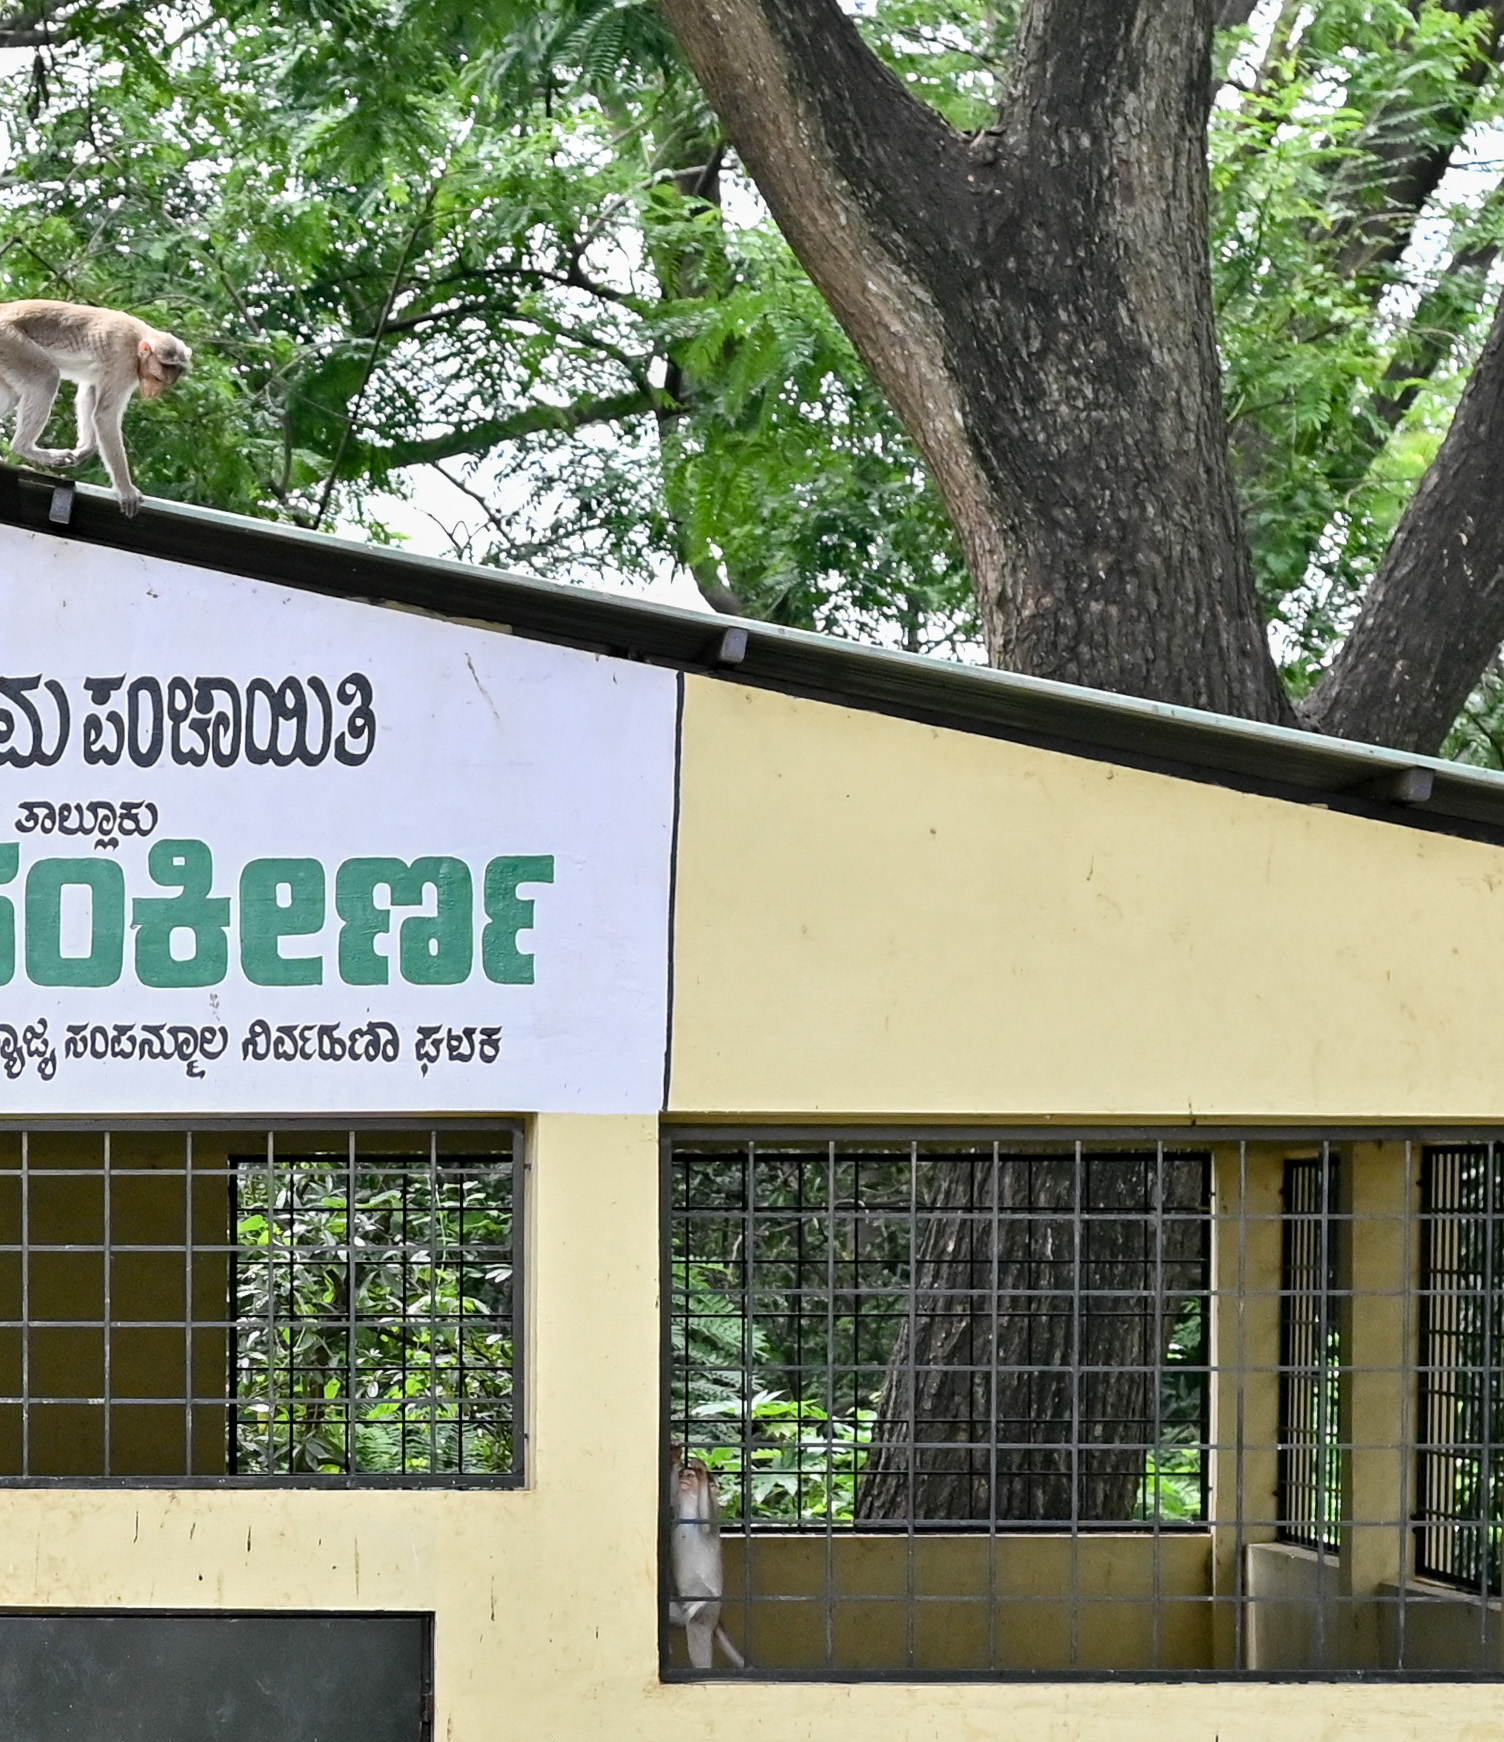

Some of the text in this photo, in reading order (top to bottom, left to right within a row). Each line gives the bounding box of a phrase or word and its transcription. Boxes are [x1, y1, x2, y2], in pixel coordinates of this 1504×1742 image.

[82, 672, 377, 768] ಪಂಚಾಯಿತಿ
[14, 799, 160, 851] ತಾಲ್ಲೂಕು
[64, 1021, 229, 1079] ಸಂಪನ್ಮೂಲ
[241, 1018, 401, 1063] ನಿರ್ವಹಣಾ
[414, 1023, 503, 1078] ಘಟಕ
